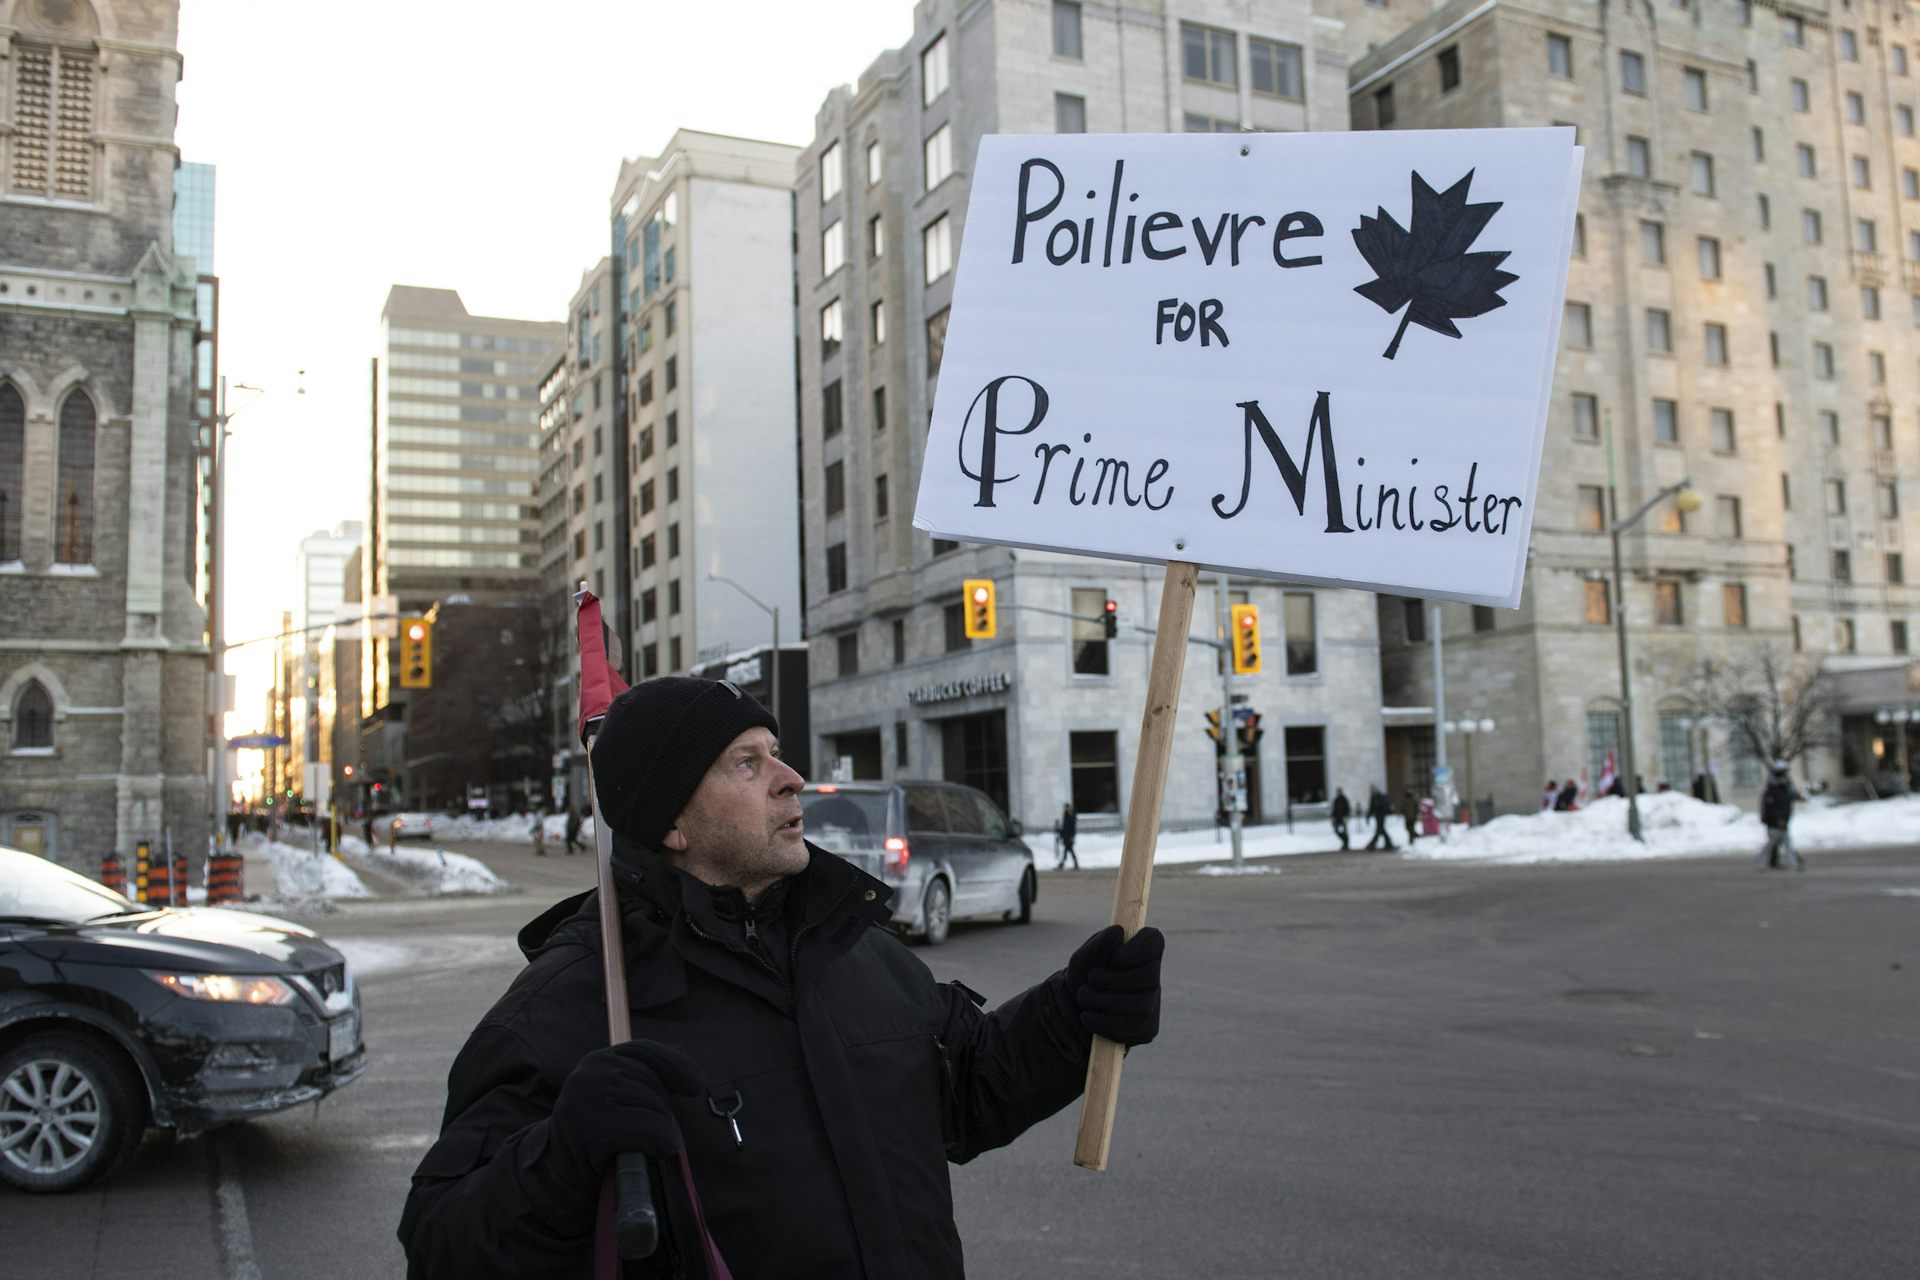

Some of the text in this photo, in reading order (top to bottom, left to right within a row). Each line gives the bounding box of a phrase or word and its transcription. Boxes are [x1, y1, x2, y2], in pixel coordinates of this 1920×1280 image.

[1012, 158, 1325, 269] Poilievre
[1157, 298, 1229, 347] FOR
[959, 376, 1523, 535] Prime Minister
